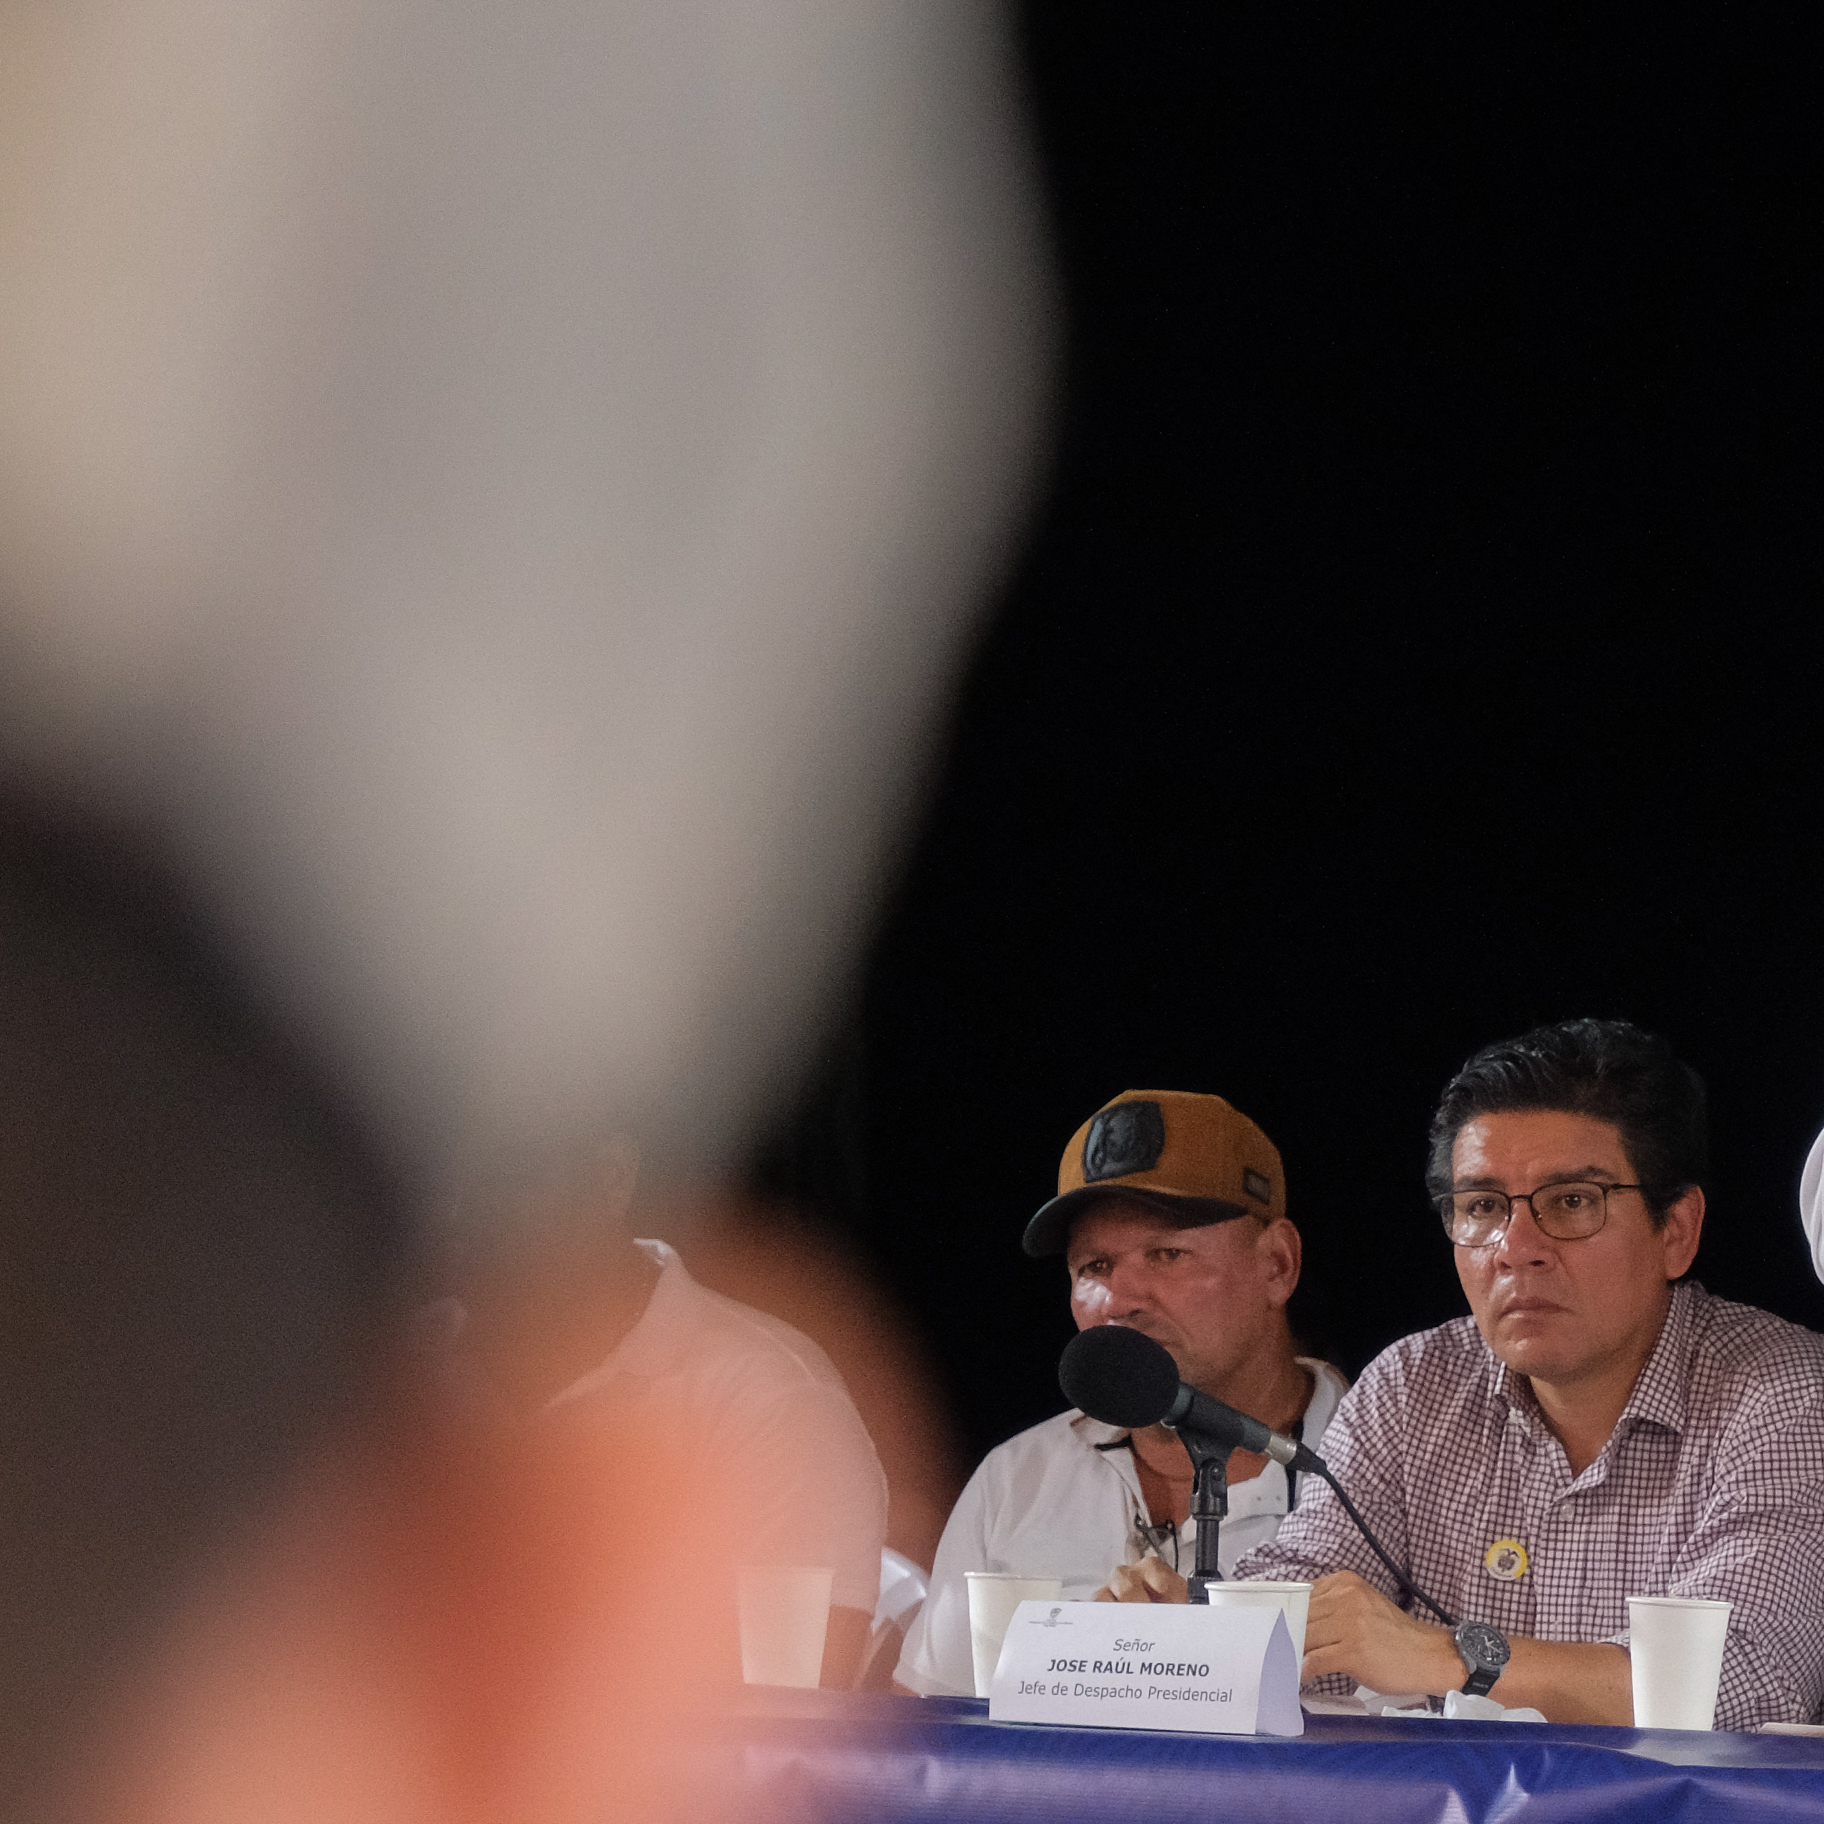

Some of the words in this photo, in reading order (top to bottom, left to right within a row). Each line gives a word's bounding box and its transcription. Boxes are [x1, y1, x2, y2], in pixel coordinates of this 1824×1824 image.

[1113, 1639, 1155, 1652] Señor
[1047, 1659, 1087, 1673] JOSE
[1093, 1658, 1134, 1675] RAÚL
[1140, 1662, 1210, 1677] MORENO
[1018, 1681, 1046, 1696] Jefe
[1051, 1682, 1068, 1696] de
[1073, 1683, 1143, 1701] Despacho
[1148, 1685, 1233, 1703] Presidencial
